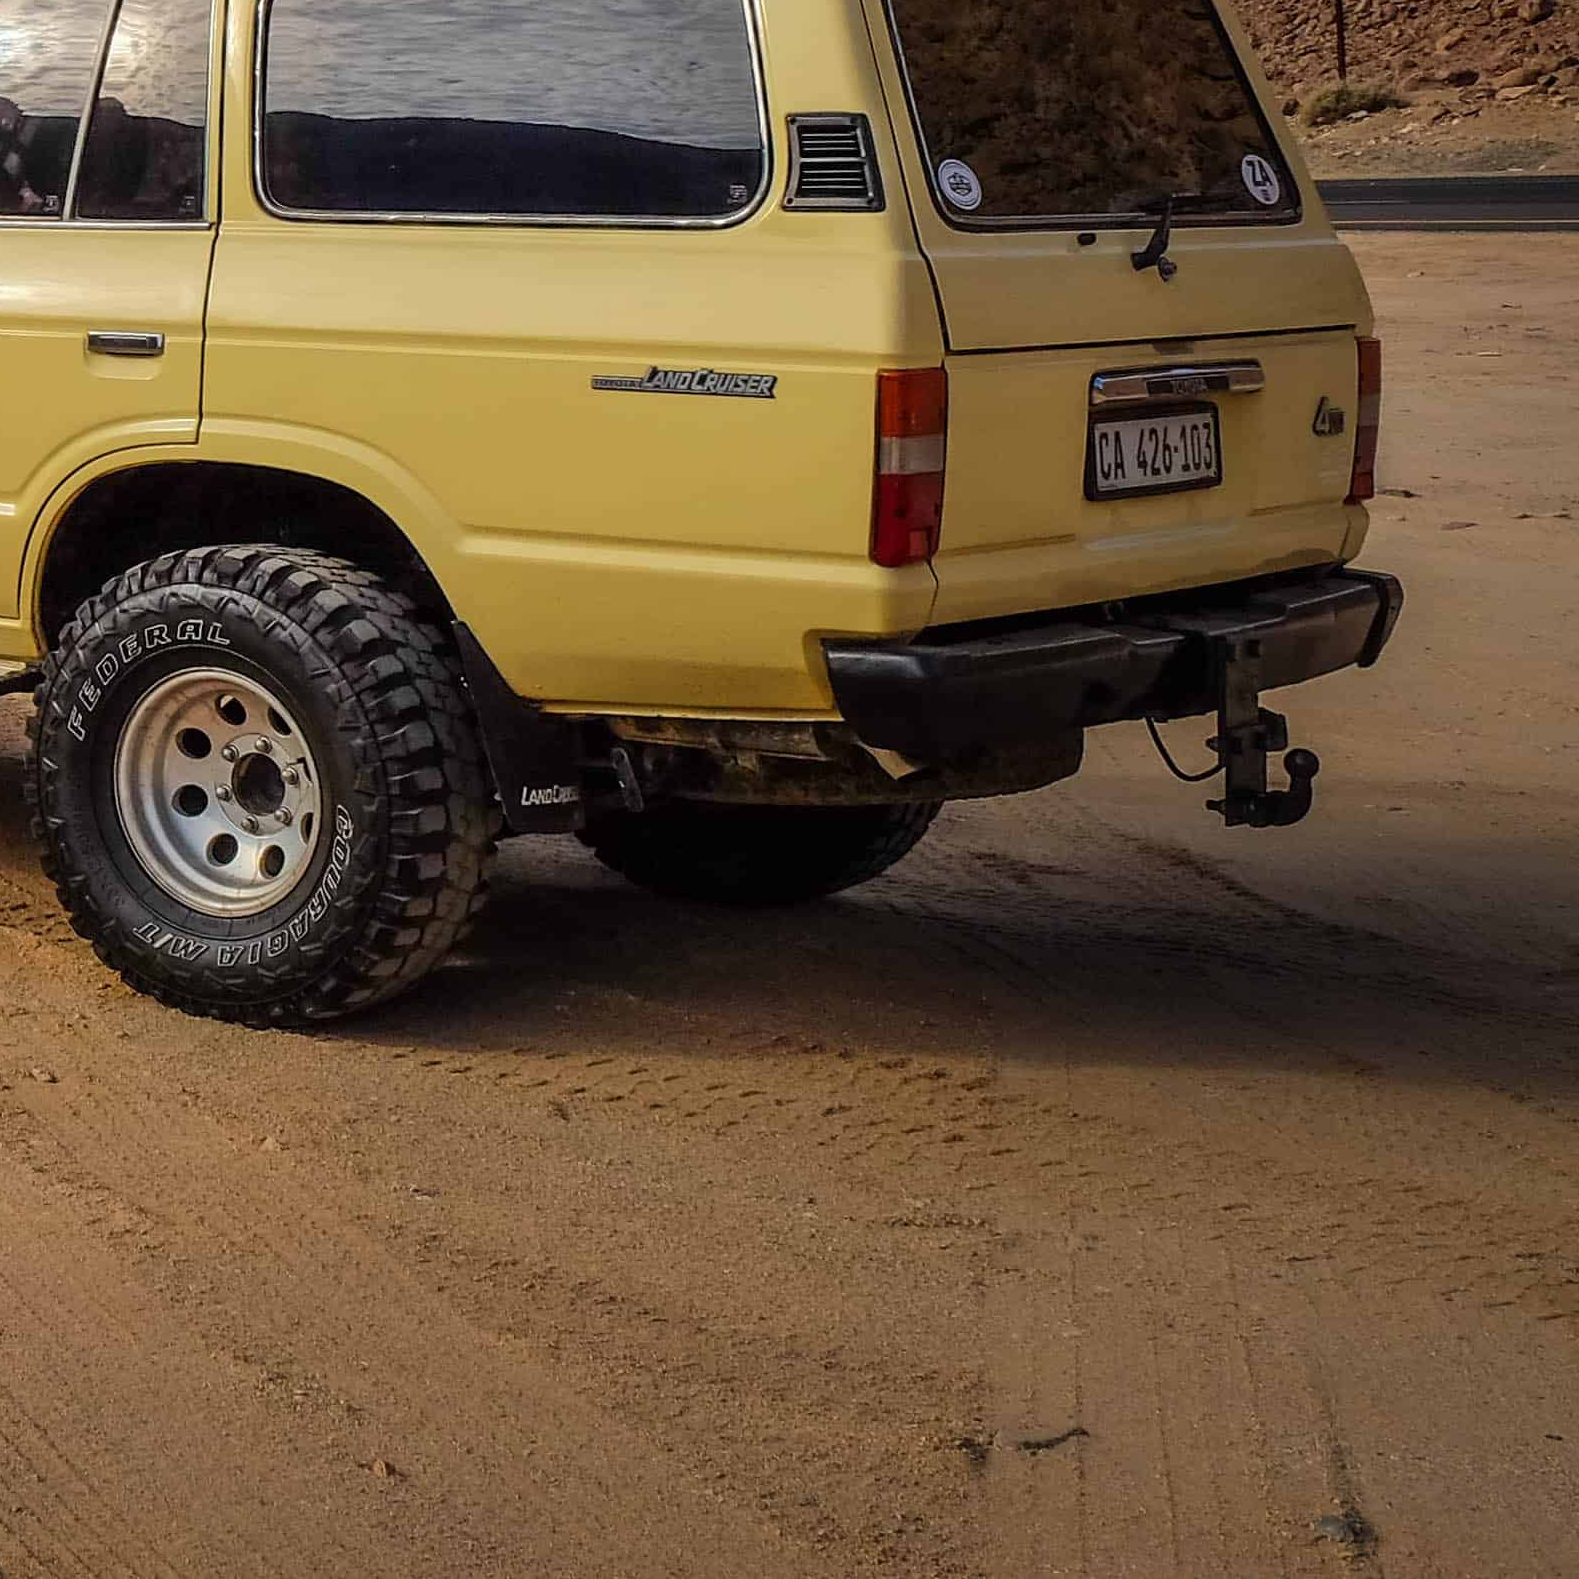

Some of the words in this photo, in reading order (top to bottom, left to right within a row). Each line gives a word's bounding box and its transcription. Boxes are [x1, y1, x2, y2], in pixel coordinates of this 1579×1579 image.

[1245, 160, 1273, 186] ZA
[1099, 430, 1126, 481] CA
[67, 619, 231, 741] FEDERAL
[217, 804, 355, 967] COURAGIA
[132, 922, 209, 961] M/T
